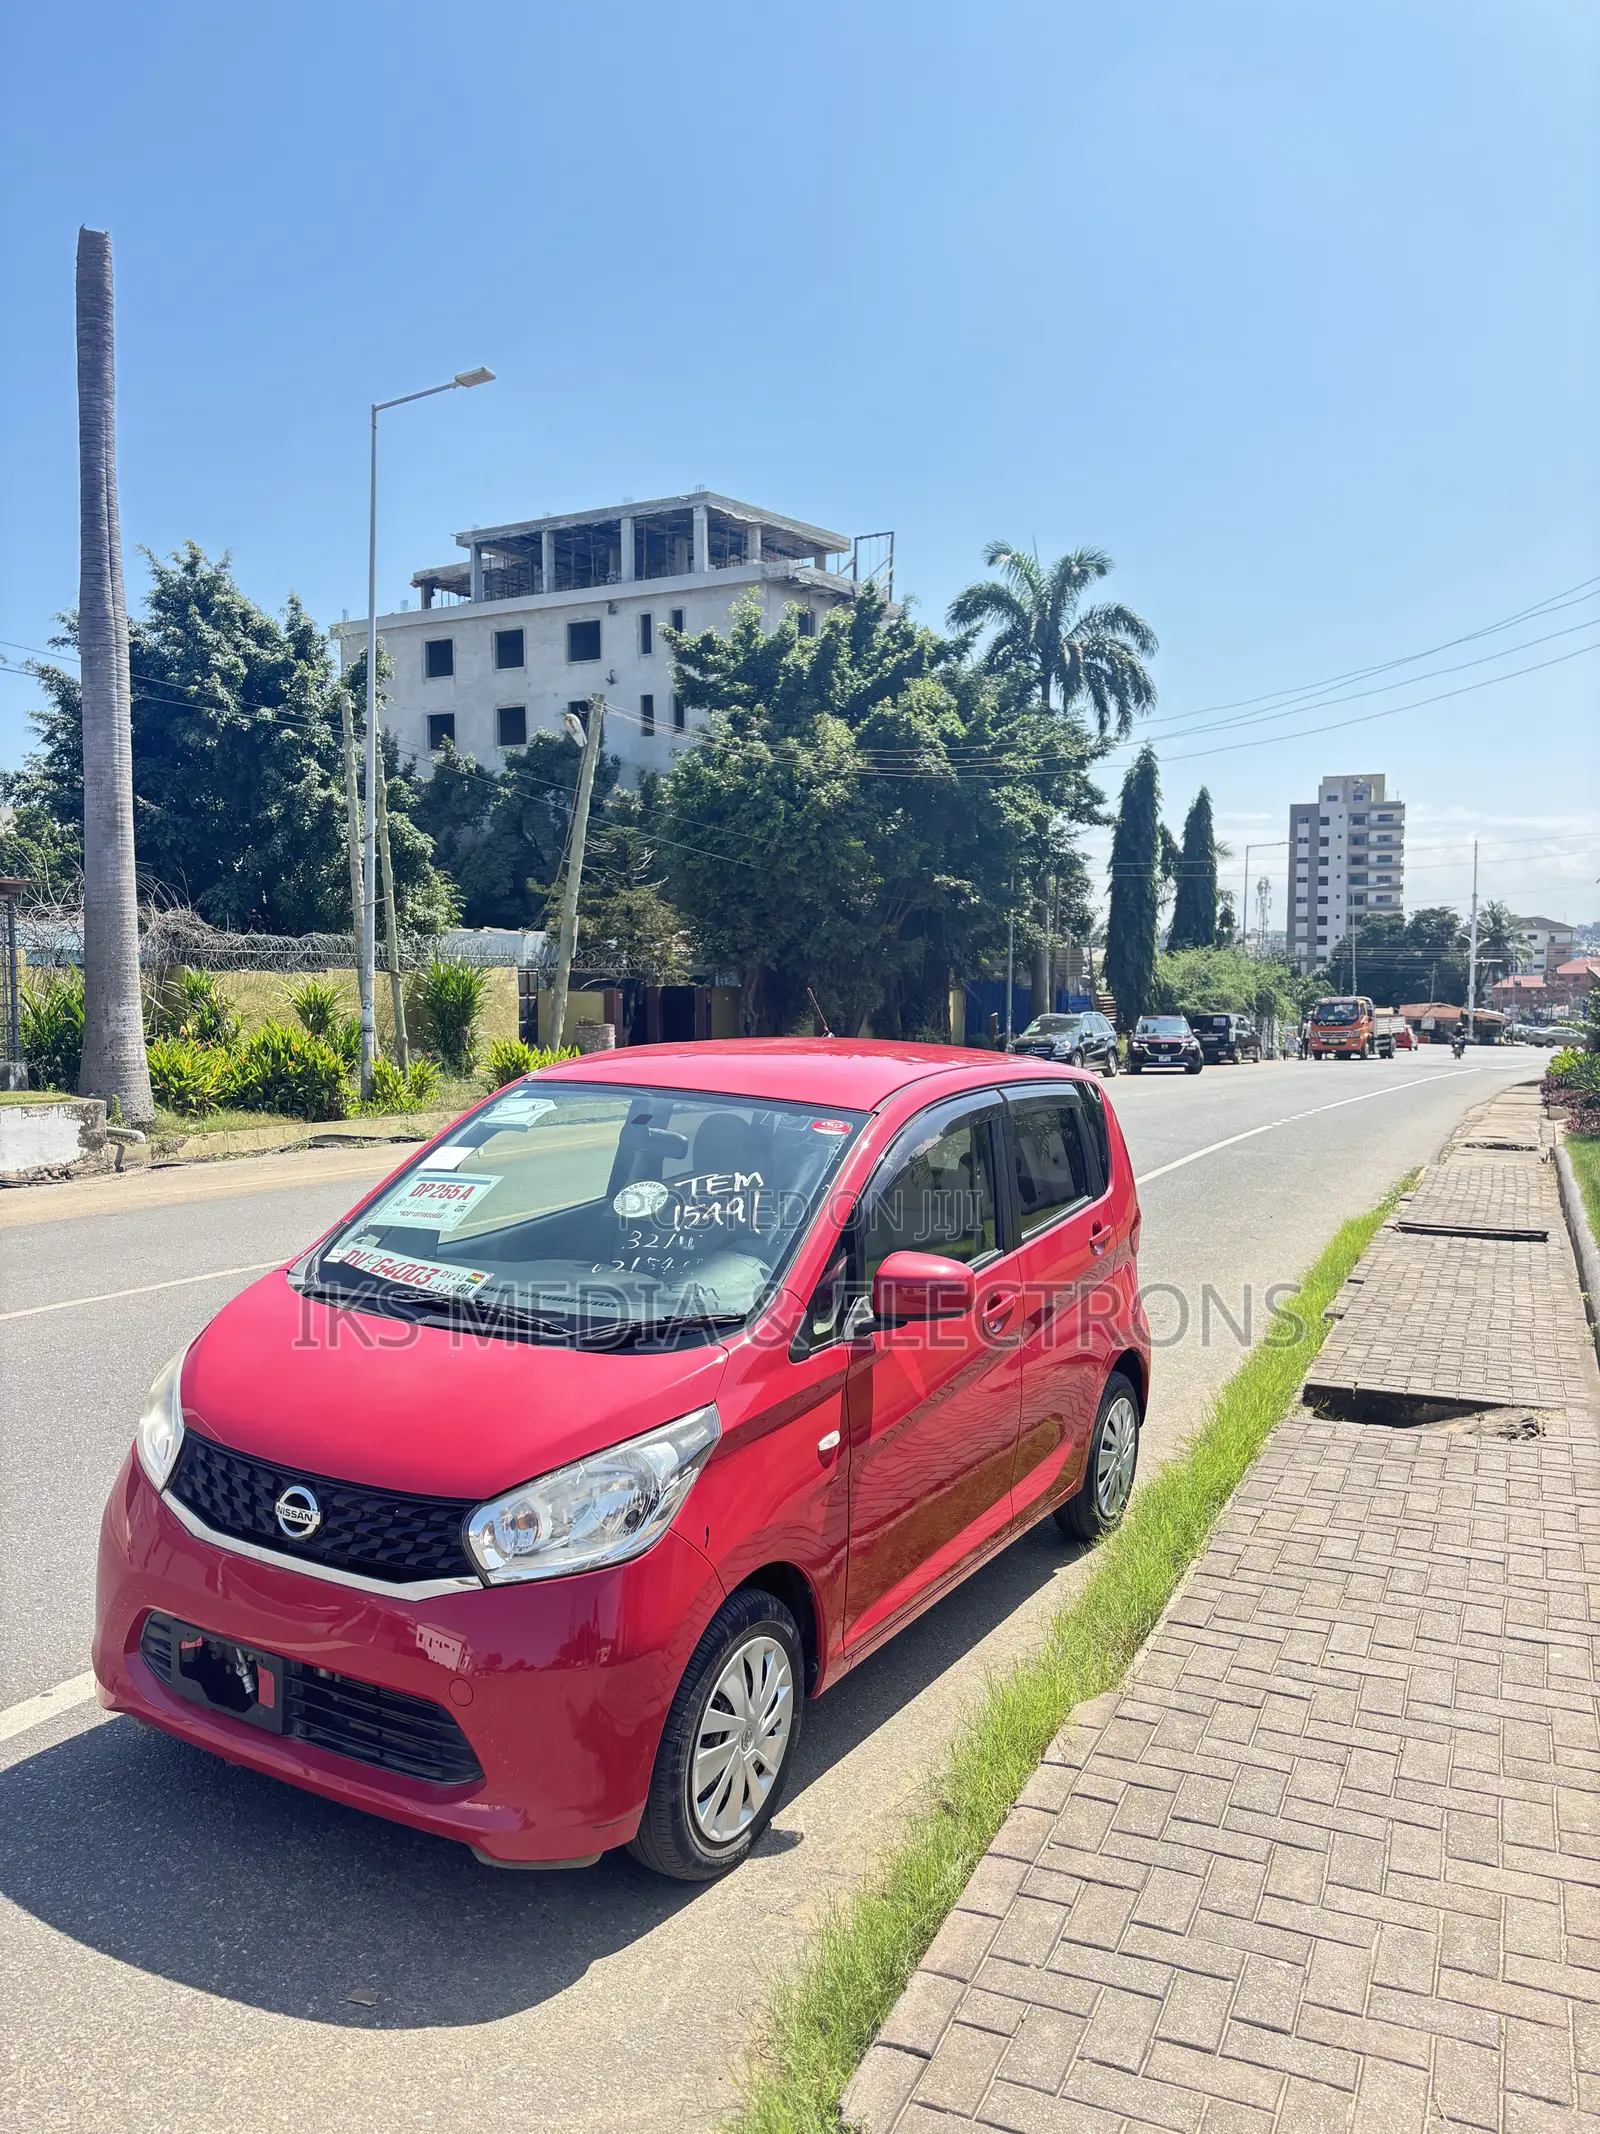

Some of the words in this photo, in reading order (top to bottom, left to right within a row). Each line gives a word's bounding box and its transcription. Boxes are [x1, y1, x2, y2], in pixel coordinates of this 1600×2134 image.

[409, 1183, 434, 1198] DP
[428, 1183, 465, 1200] 255
[458, 1185, 476, 1201] A
[674, 1171, 764, 1198] TEM
[455, 1283, 475, 1296] GH
[277, 1505, 313, 1522] NISSAN
